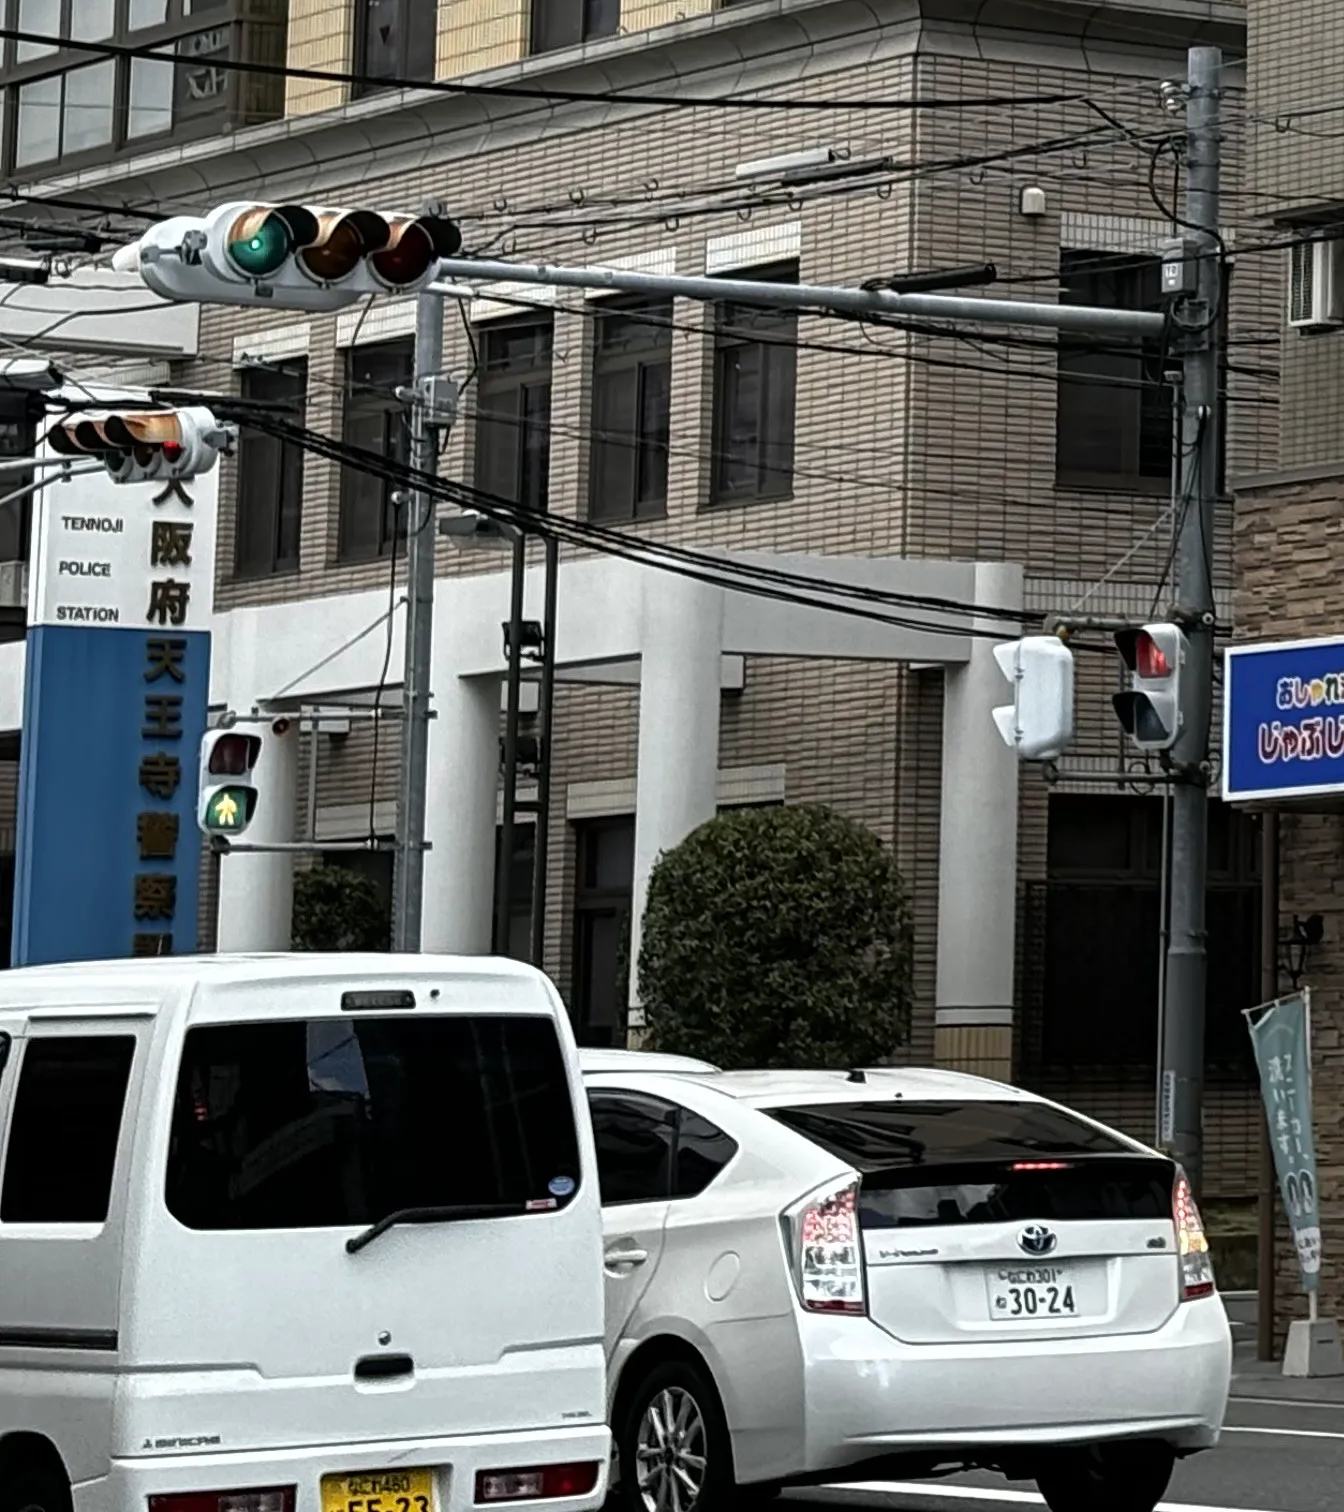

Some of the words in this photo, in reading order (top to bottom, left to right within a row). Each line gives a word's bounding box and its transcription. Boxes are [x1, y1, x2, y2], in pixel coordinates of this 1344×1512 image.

[61, 515, 124, 534] TENNOJI
[58, 560, 112, 577] POLICE
[56, 605, 119, 622] STATION
[1008, 1285, 1075, 1315] 30-24
